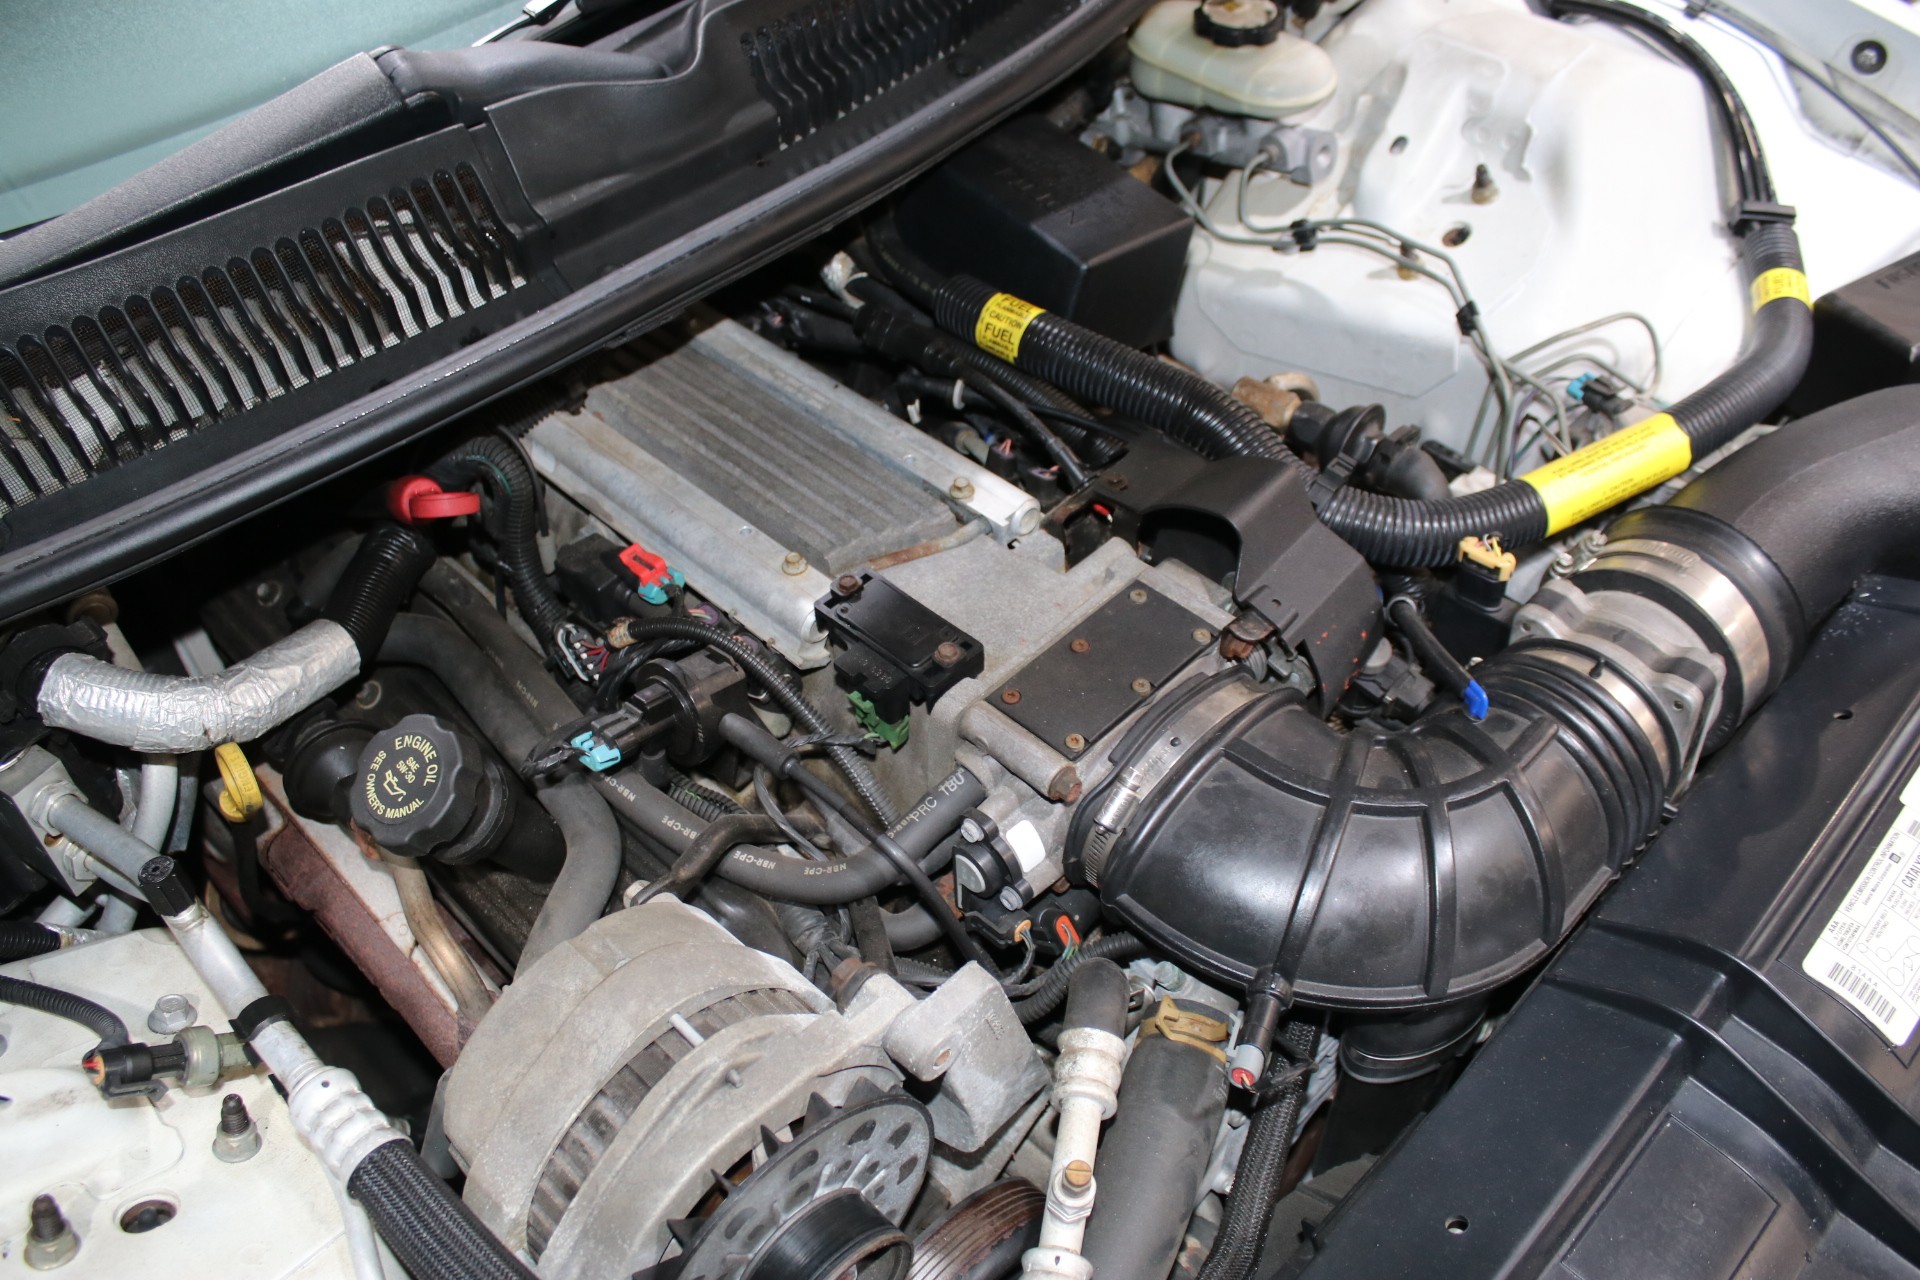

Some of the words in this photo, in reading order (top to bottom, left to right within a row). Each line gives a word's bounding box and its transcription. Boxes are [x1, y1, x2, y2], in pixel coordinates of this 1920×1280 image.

[989, 310, 1023, 329] CAUTION
[985, 322, 1014, 345] FUEL
[370, 750, 387, 771] SEE
[394, 734, 437, 763] ENGINE
[424, 764, 438, 786] OIL
[406, 756, 420, 773] SAE
[396, 760, 416, 783] 5W-30
[366, 774, 386, 815] OWNER'S
[385, 798, 424, 818] MANUAL
[911, 797, 937, 822] PRC
[661, 815, 700, 839] BR-CPE
[733, 851, 776, 870] NBR-CPE
[804, 863, 847, 875] NBR-CPE
[1828, 920, 1840, 933] AAA
